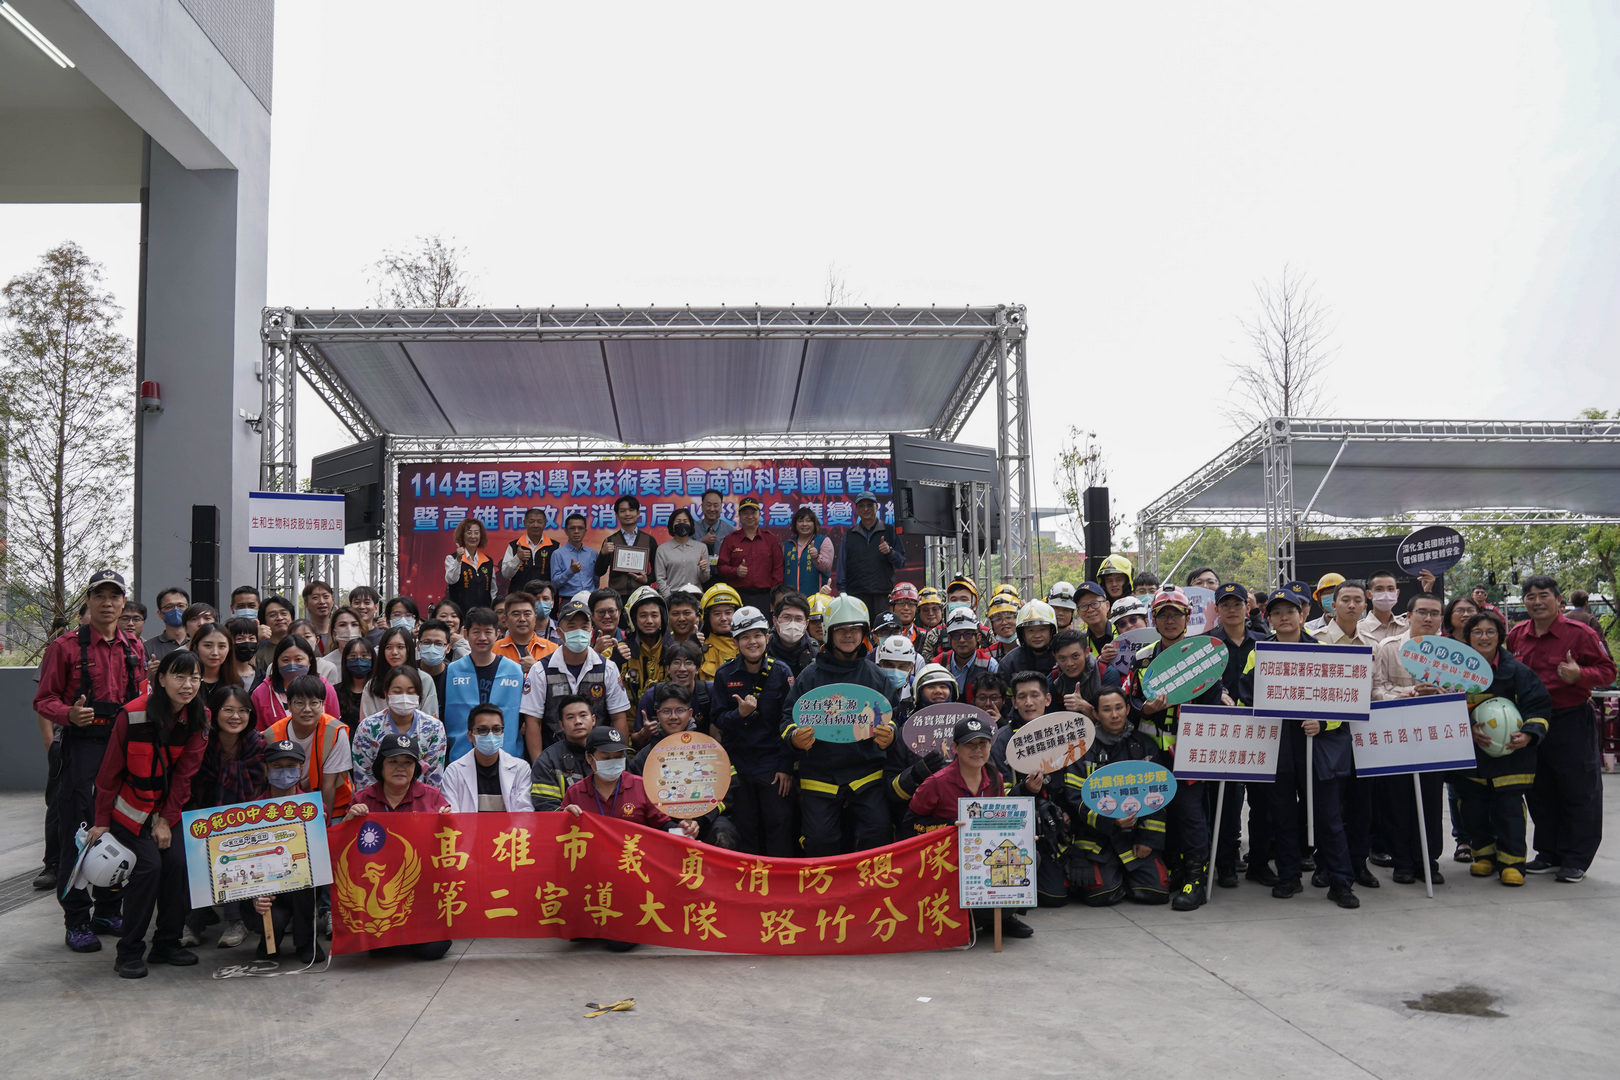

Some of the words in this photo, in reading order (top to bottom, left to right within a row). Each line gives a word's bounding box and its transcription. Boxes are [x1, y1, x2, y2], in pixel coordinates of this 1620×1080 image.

[410, 467, 893, 498] 114年國家科學及技術委員會南部科學園區管理
[251, 516, 343, 531] 生和生物科技股份有限公司
[452, 676, 471, 686] ERT
[1259, 661, 1368, 680] 內政部警政署保安警察第二總隊
[1266, 684, 1359, 703] 第四大隊第二中隊高科分隊
[1013, 716, 1085, 748] 隨地置放引火物
[1015, 728, 1087, 760] 大難臨頭最痛苦
[1182, 721, 1279, 741] 高雄市政府消防局
[1353, 722, 1469, 748] 高雄市路竹區公所
[1188, 748, 1267, 766] 第五救災救護大隊
[192, 804, 315, 837] 防範CO中毒宣導
[430, 824, 959, 897] 高雄市義勇消防總隊
[432, 880, 728, 942] 第二宣導大隊
[760, 887, 962, 946] 路竹分隊
